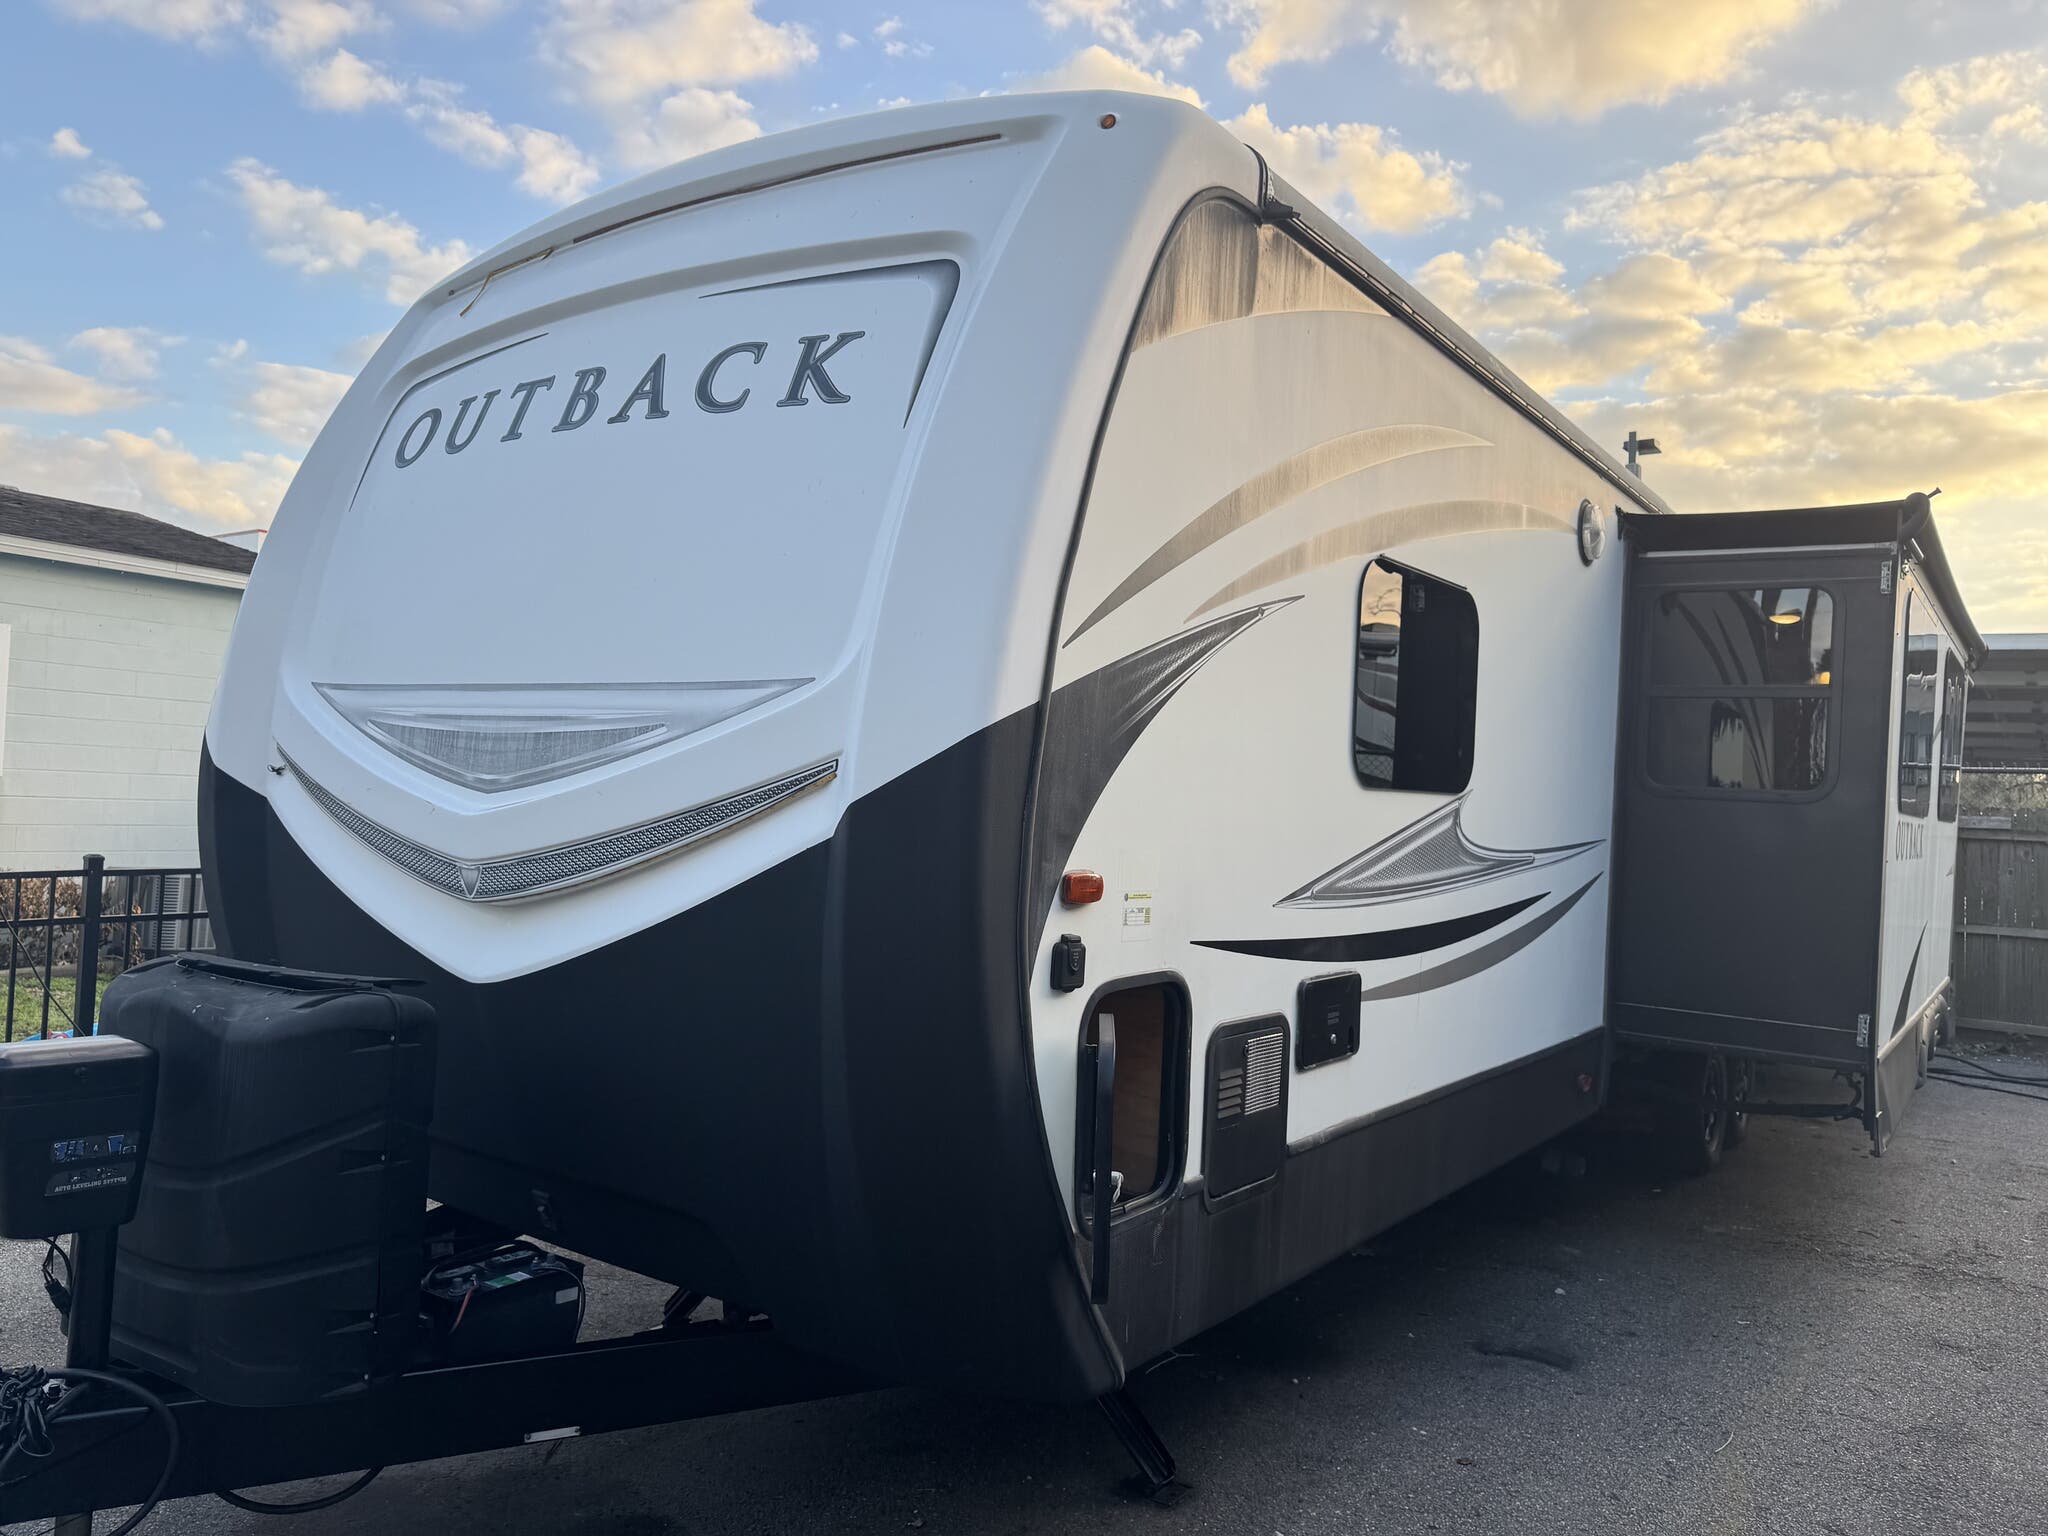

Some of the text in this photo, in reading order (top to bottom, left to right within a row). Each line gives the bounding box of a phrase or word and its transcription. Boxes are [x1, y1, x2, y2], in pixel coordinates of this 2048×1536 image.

[394, 331, 866, 469] OUTBACK
[54, 1176, 127, 1193] AUTO LEVELING SYSTEM
